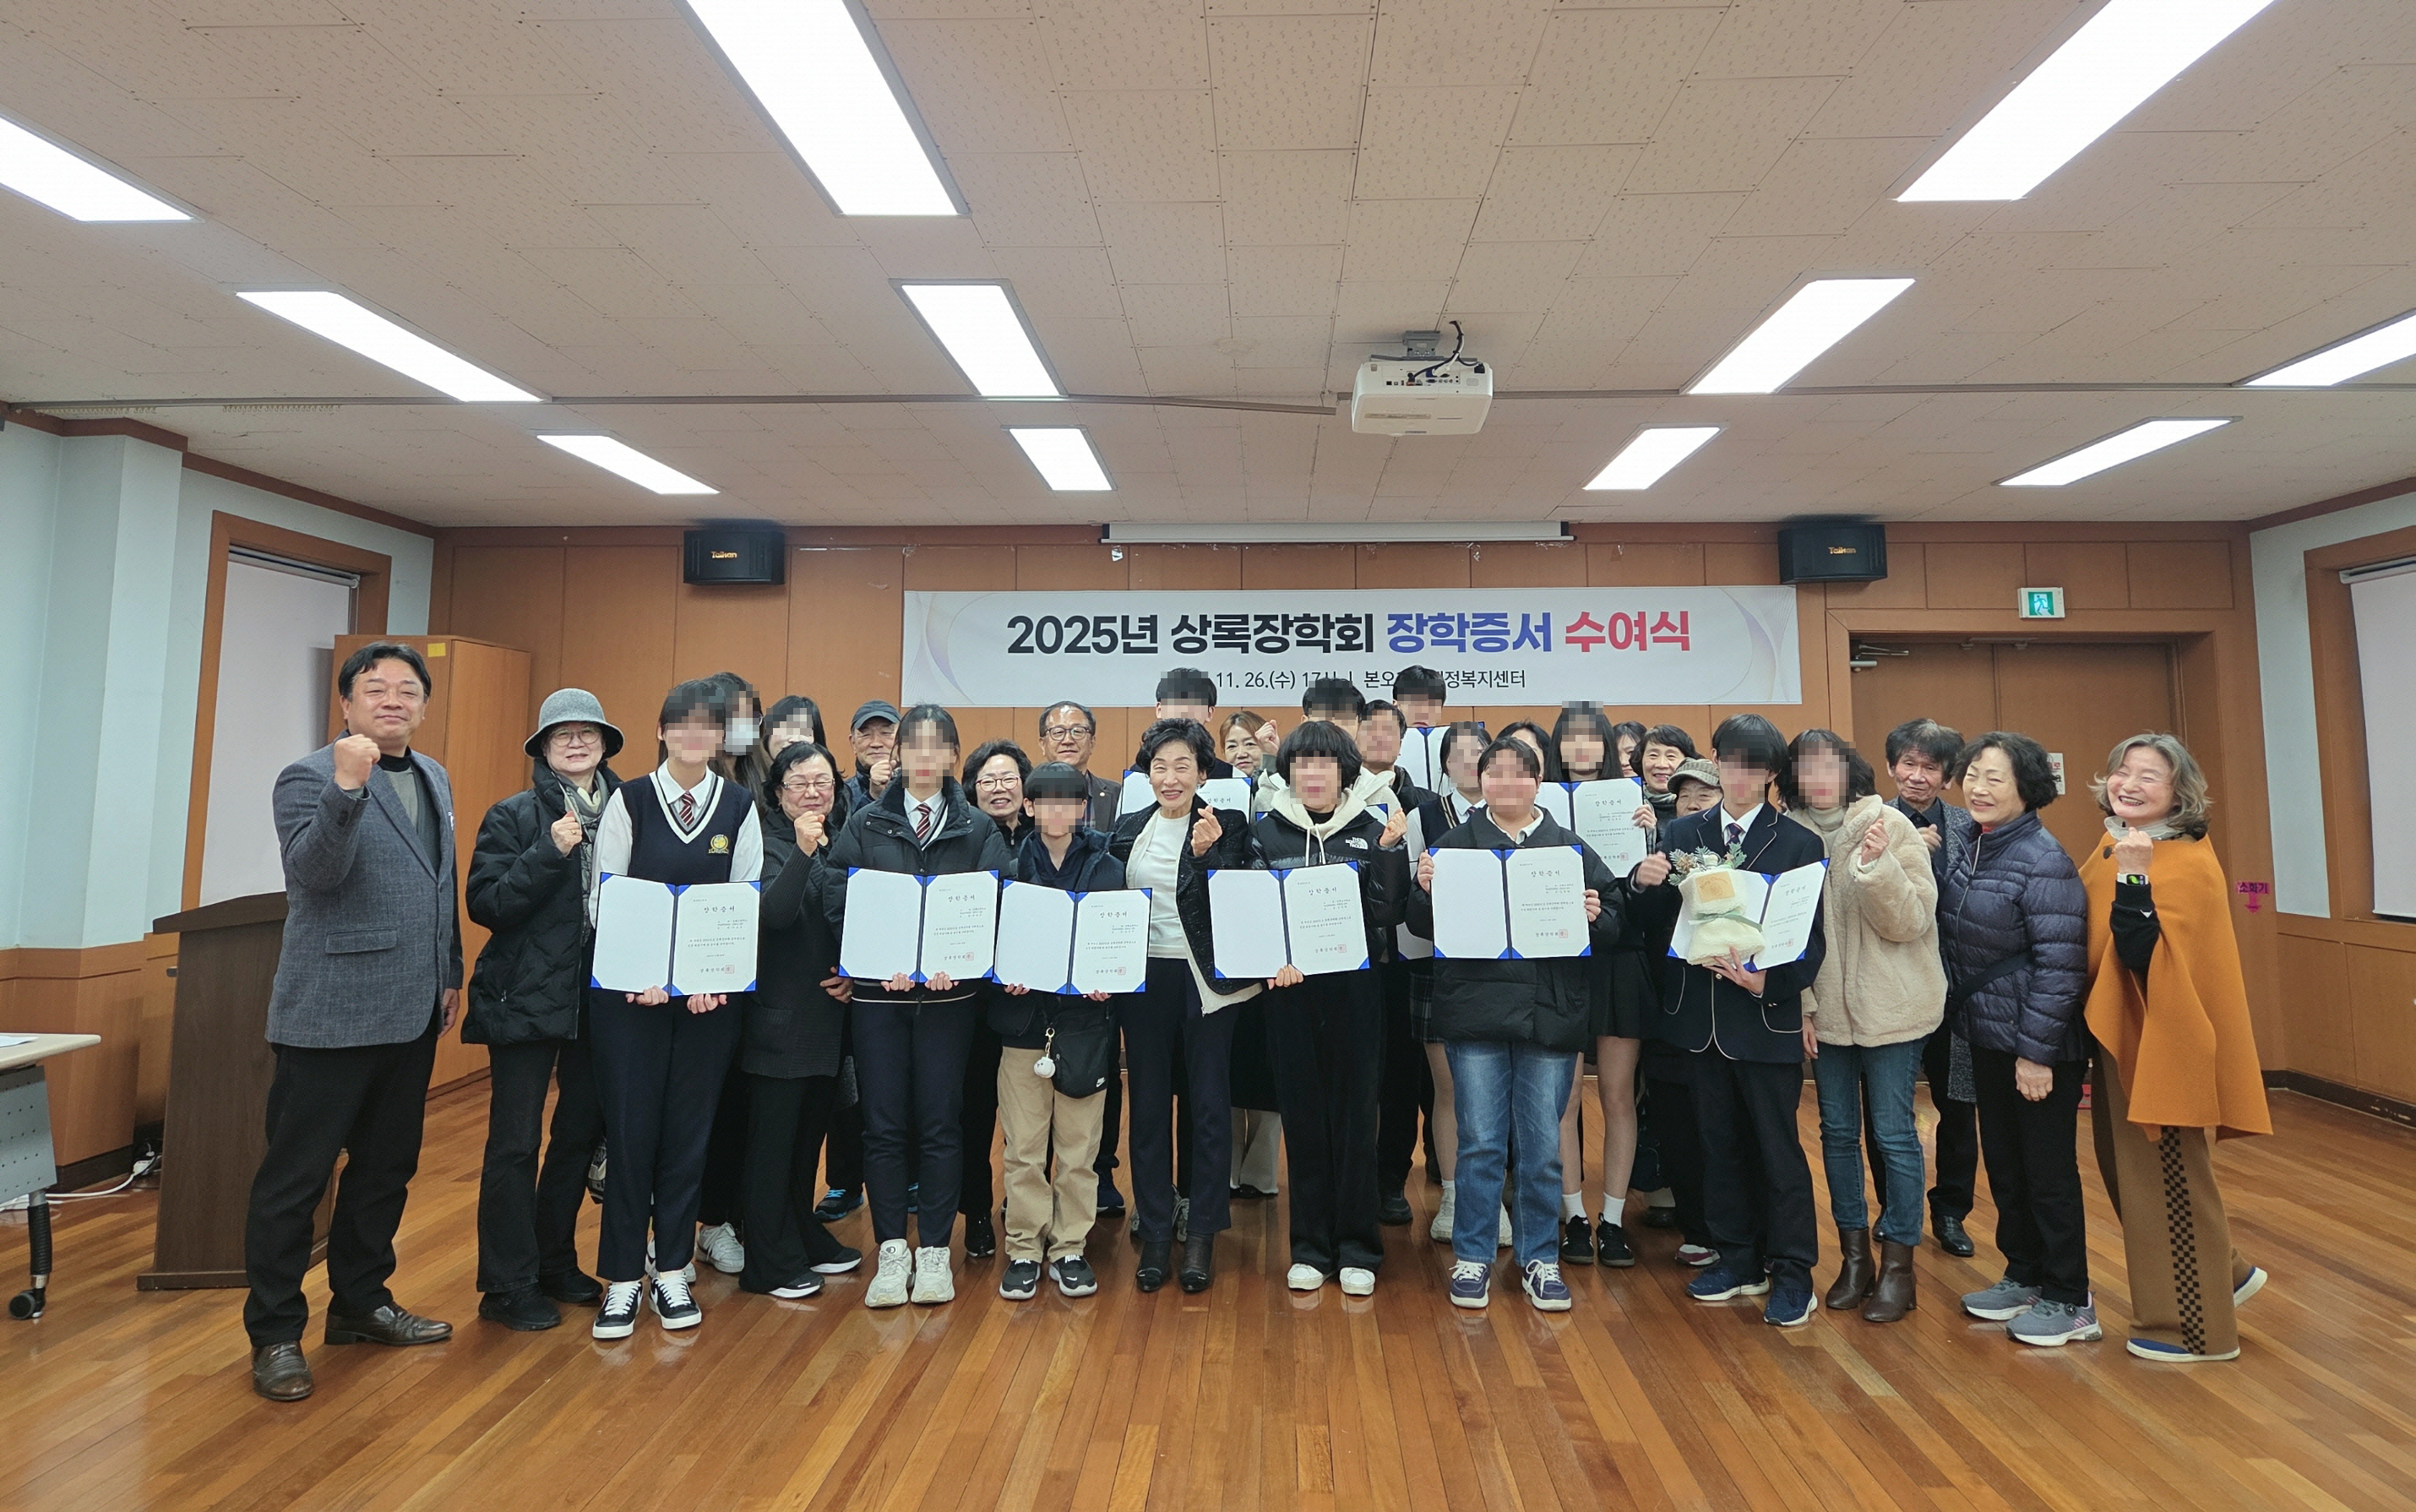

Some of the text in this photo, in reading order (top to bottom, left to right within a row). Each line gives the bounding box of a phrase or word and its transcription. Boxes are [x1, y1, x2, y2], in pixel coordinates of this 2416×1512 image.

[1007, 611, 1690, 655] 2025년 상록장학회 장학증서 수여식
[1244, 671, 1296, 689] 26.(수)
[2239, 882, 2268, 895] 소화기
